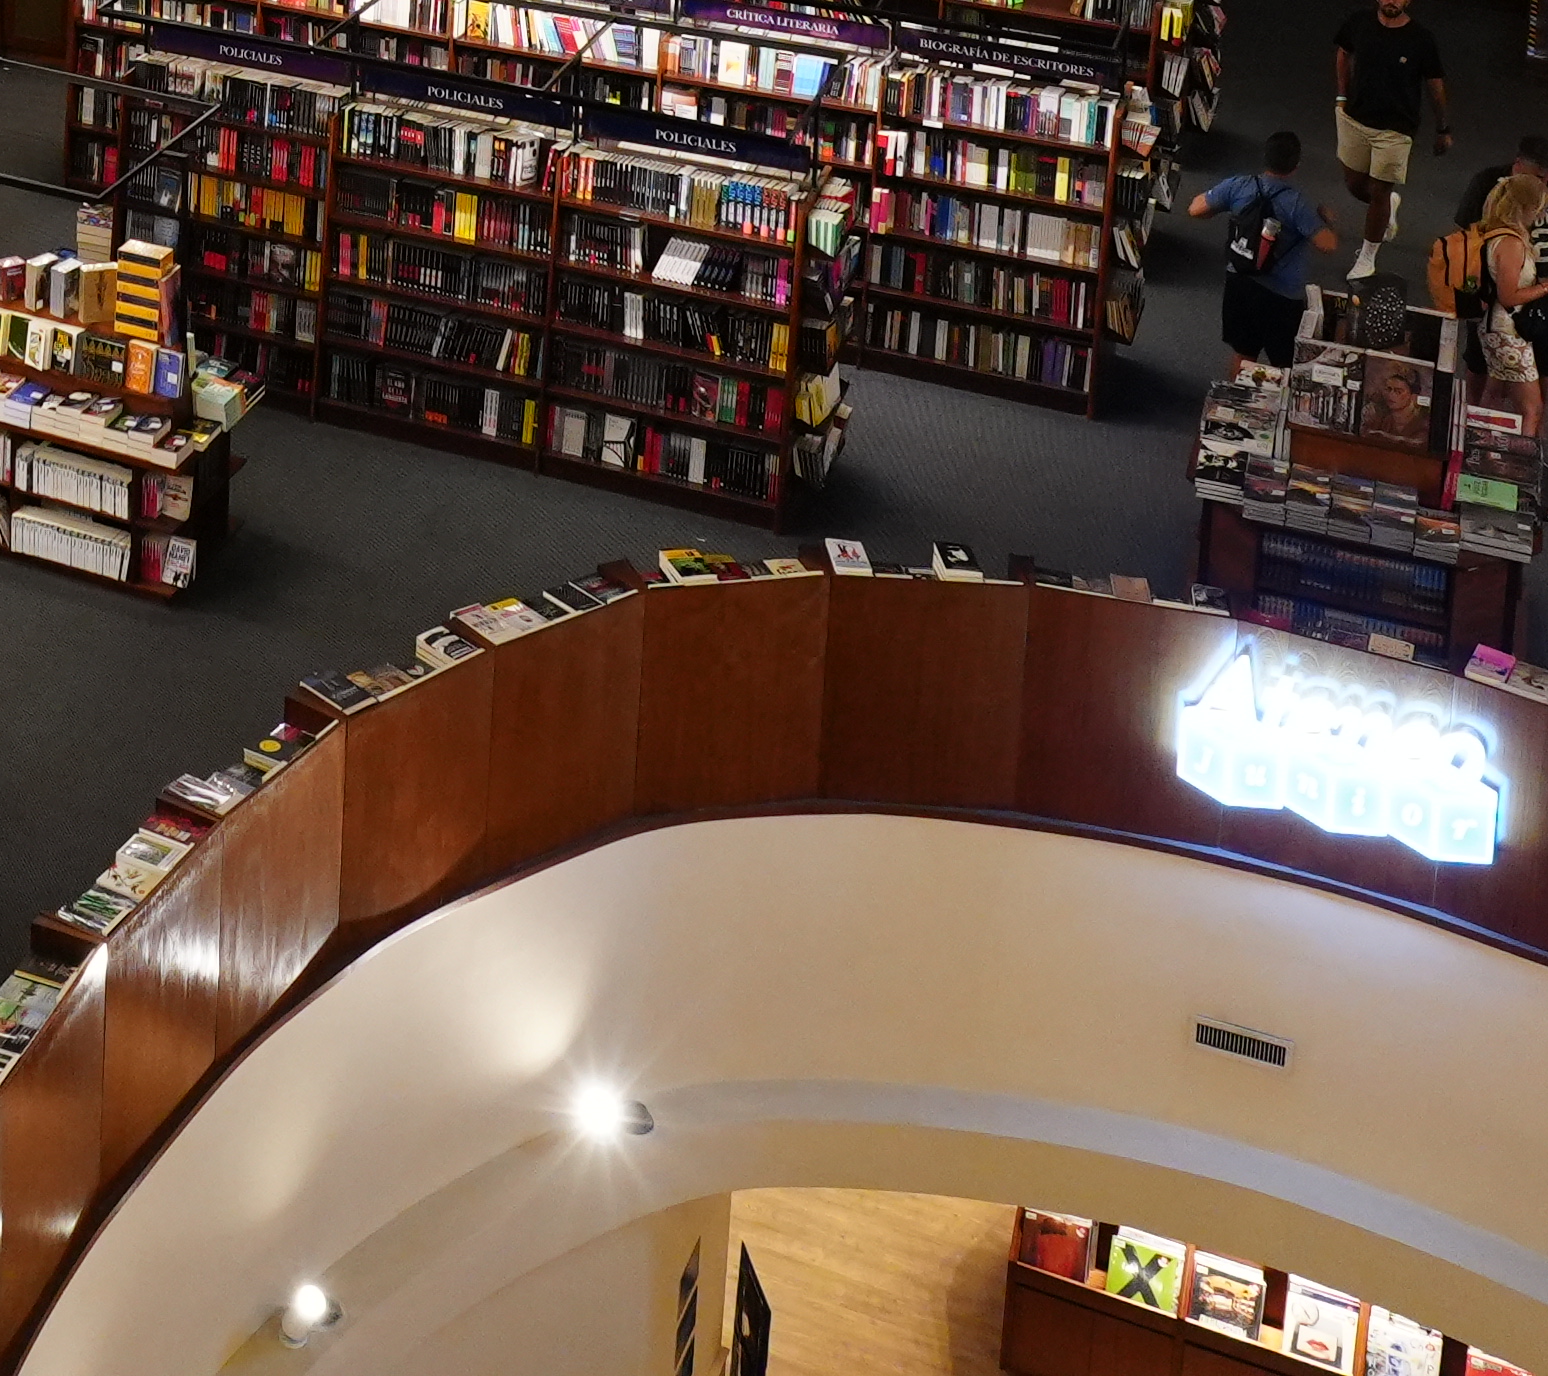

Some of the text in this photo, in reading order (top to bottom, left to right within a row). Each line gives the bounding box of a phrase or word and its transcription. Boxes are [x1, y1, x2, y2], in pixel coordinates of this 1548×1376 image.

[726, 7, 839, 36] CRÍTICA LITERARIA
[219, 44, 283, 67] POLICIALES
[919, 37, 1094, 78] BIOGRAFÍA DE ESCRITORES
[427, 85, 504, 110] POLICIALES
[655, 127, 738, 156] POLICIALES
